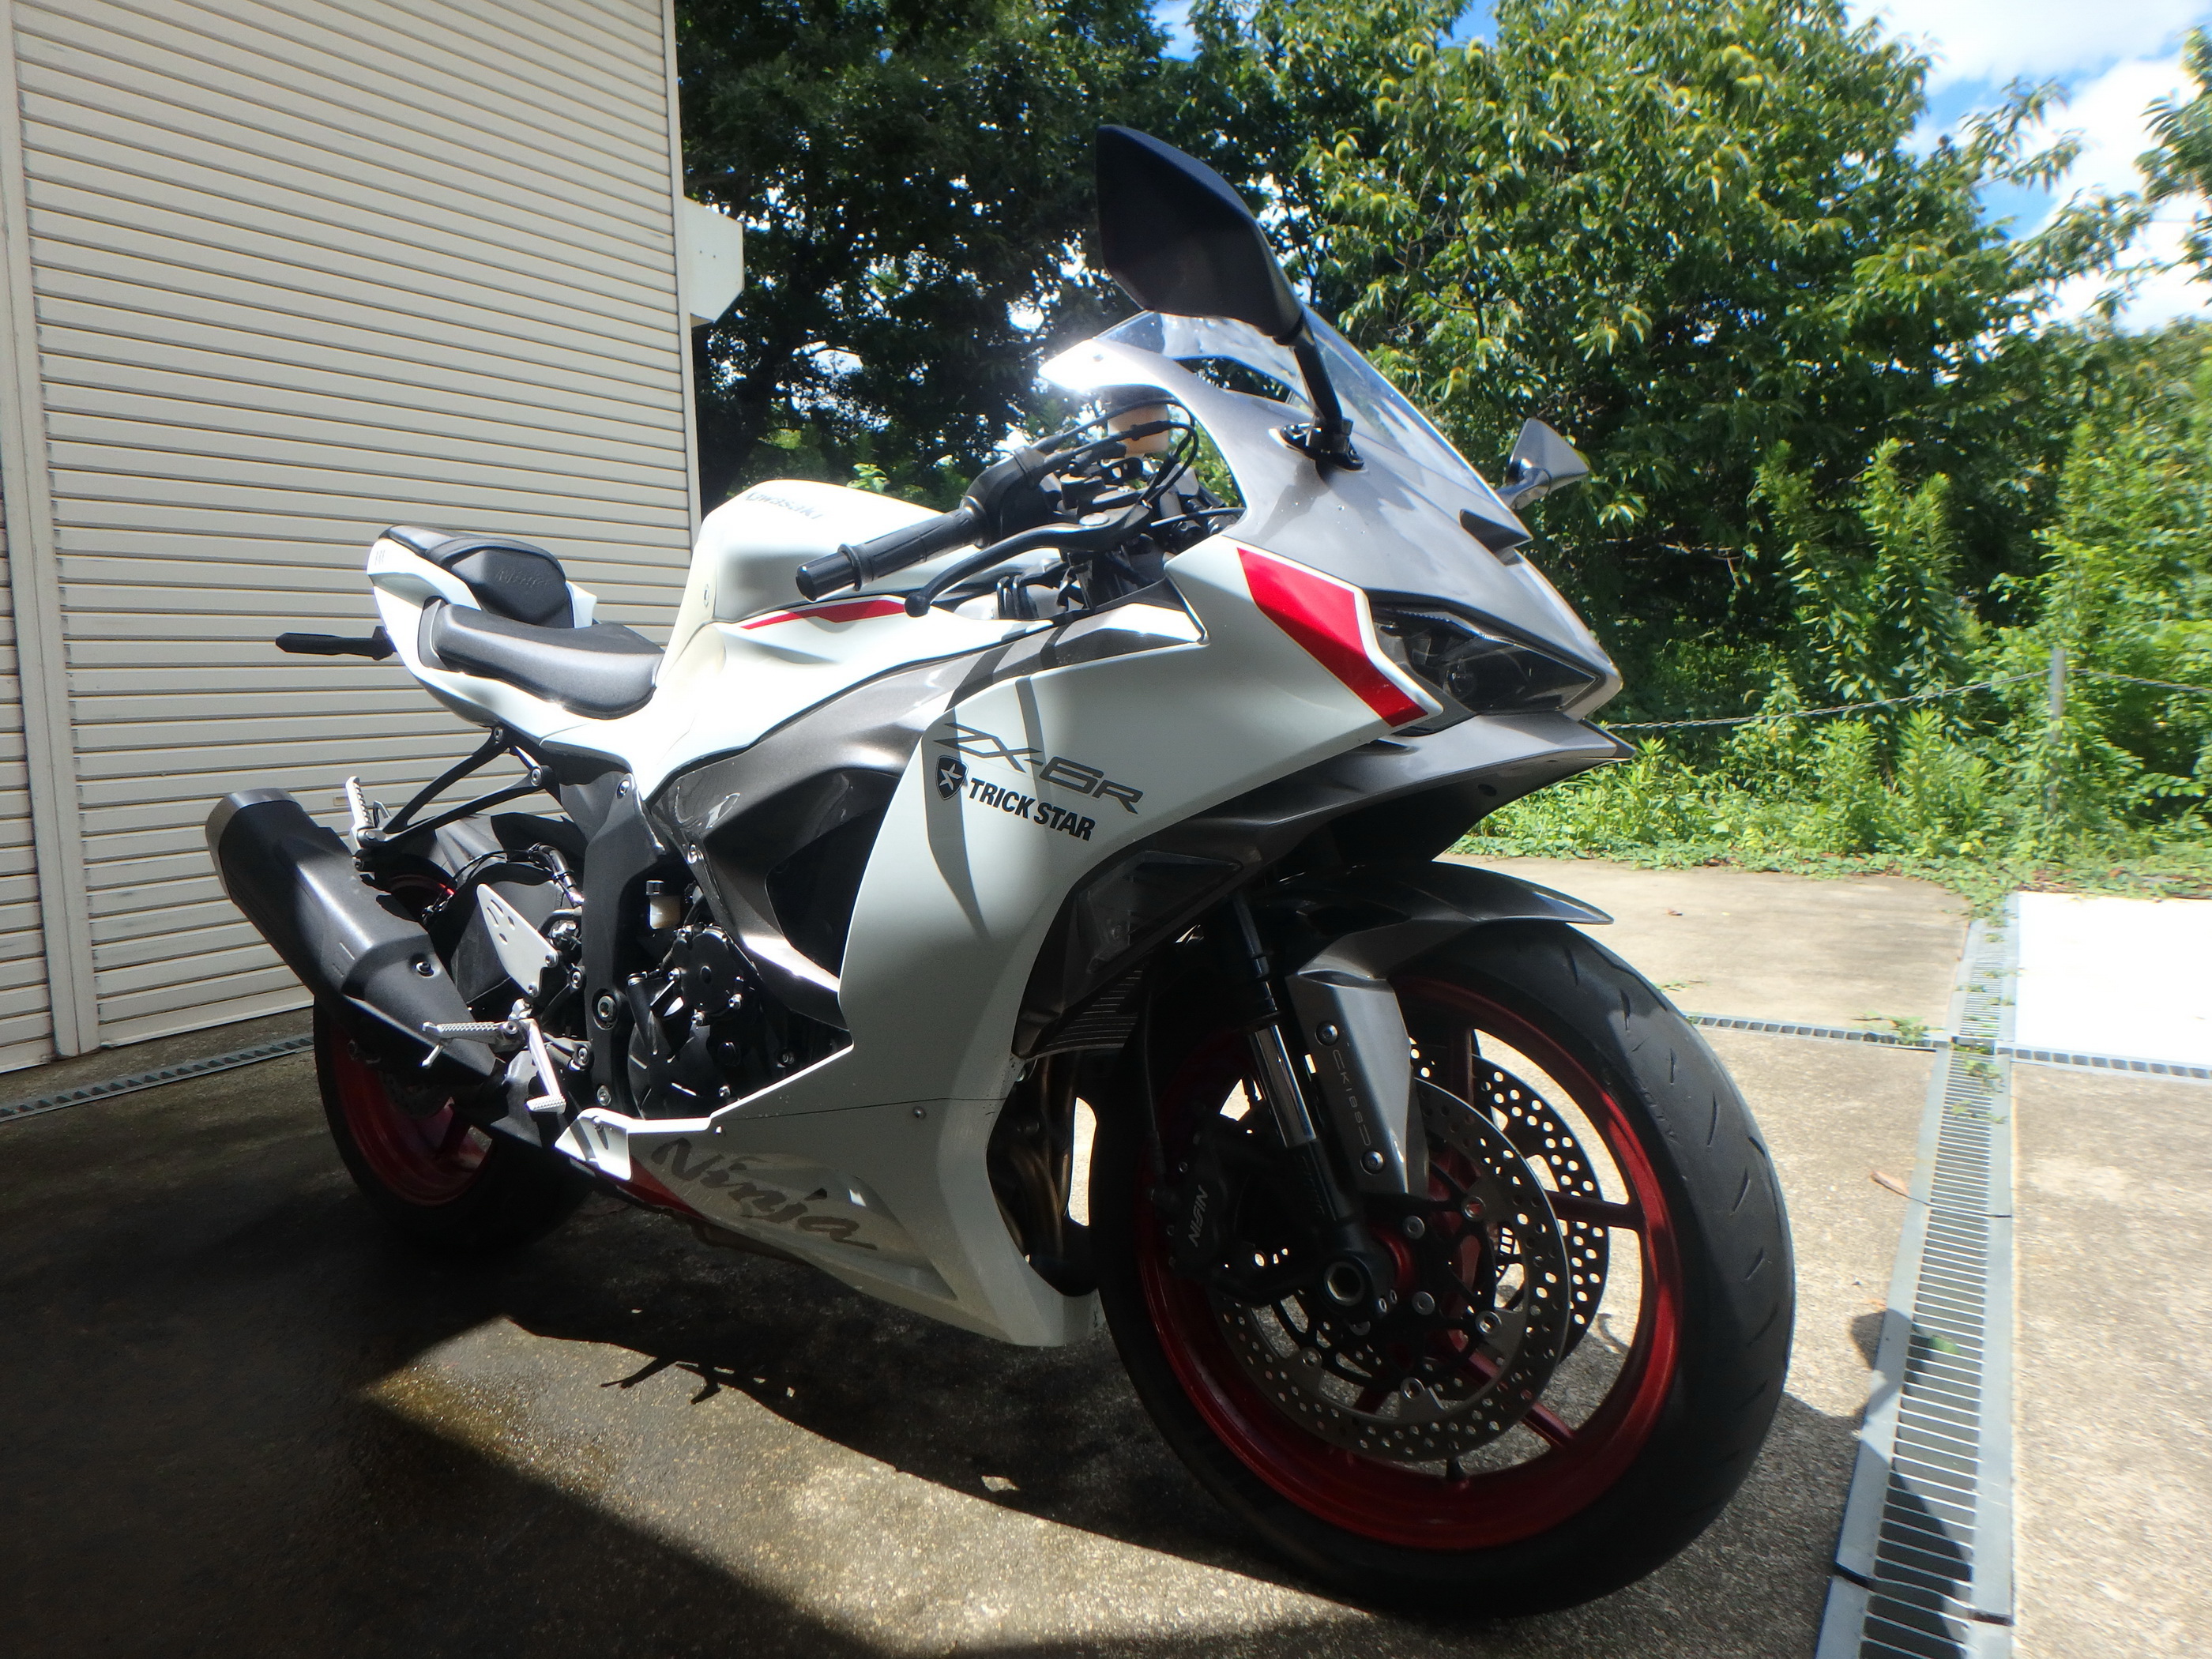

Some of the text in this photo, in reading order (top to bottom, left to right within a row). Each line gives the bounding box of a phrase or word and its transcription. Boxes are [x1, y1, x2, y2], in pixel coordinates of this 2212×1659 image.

[968, 777, 1096, 841] TRICK STAR
[650, 1137, 878, 1251] Ninja
